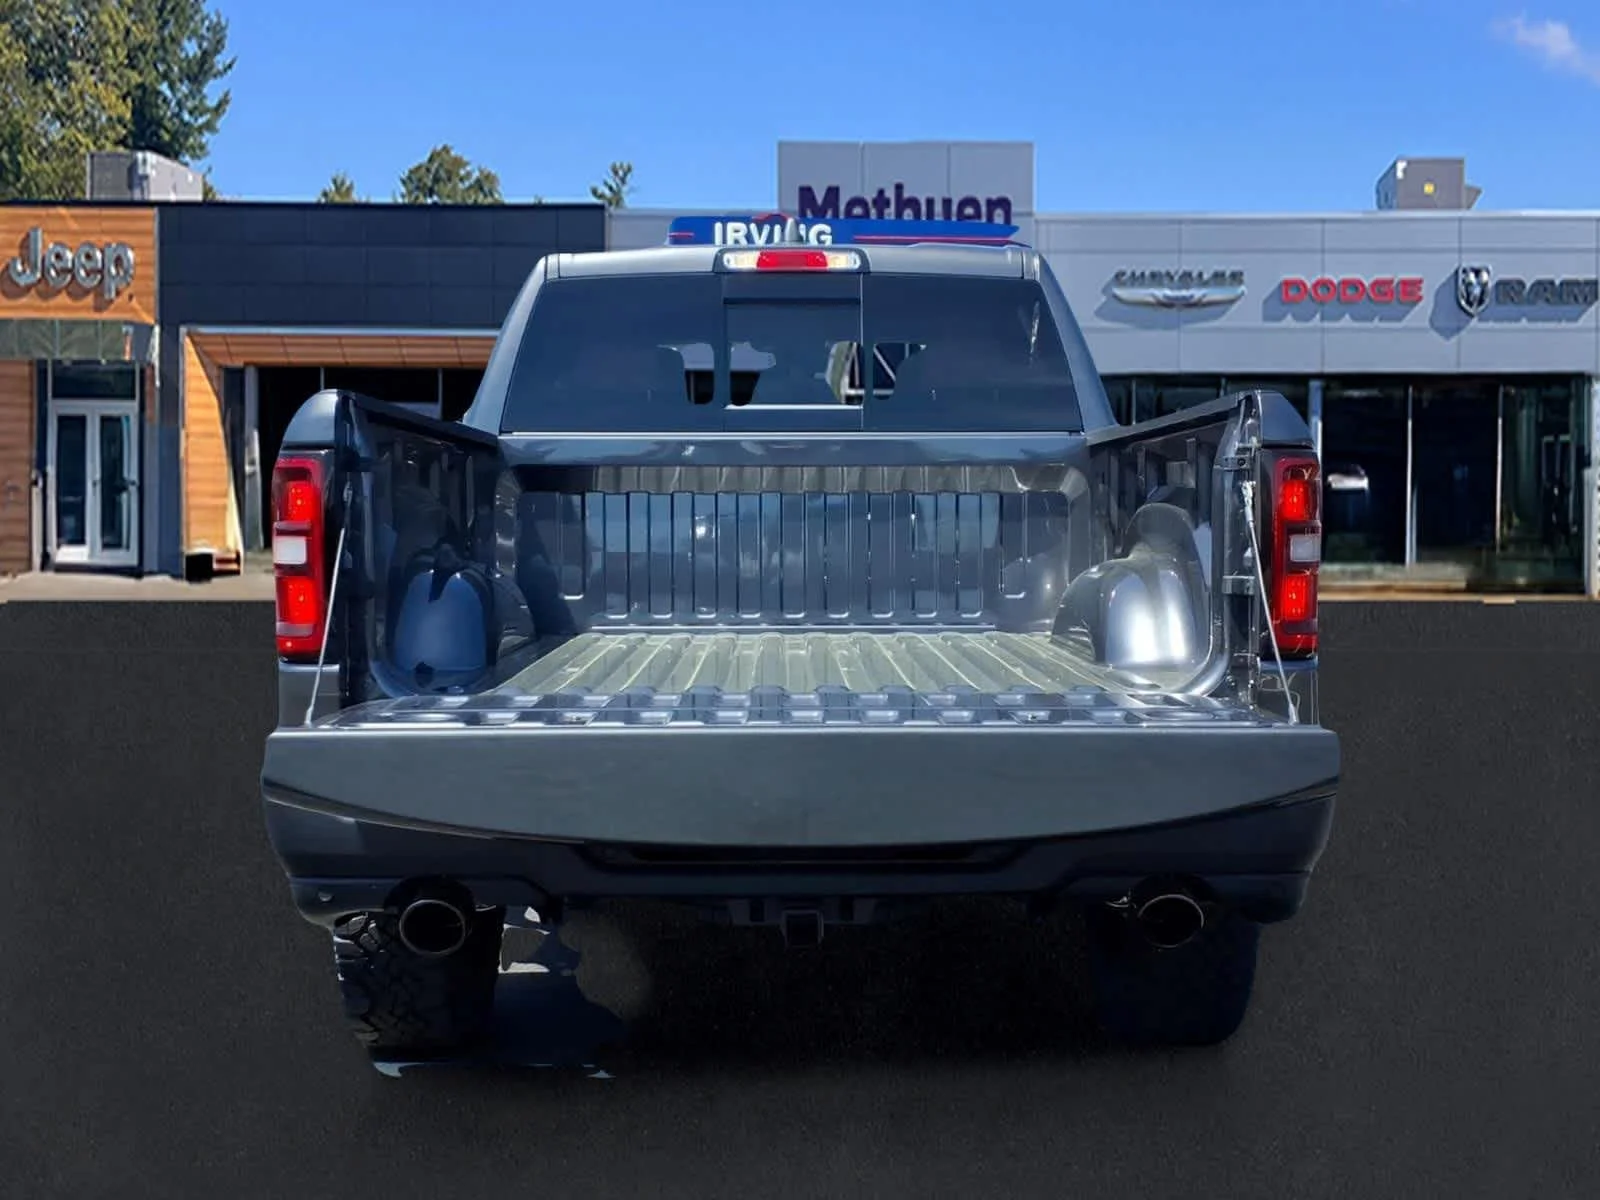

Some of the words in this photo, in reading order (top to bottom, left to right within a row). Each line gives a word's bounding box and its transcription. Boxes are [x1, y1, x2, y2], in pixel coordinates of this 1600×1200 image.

[799, 182, 1012, 225] Methuen
[9, 226, 135, 300] Jeep
[1114, 270, 1244, 287] CHRYSLER
[1281, 277, 1423, 304] DODGE
[1495, 278, 1598, 304] RAM
